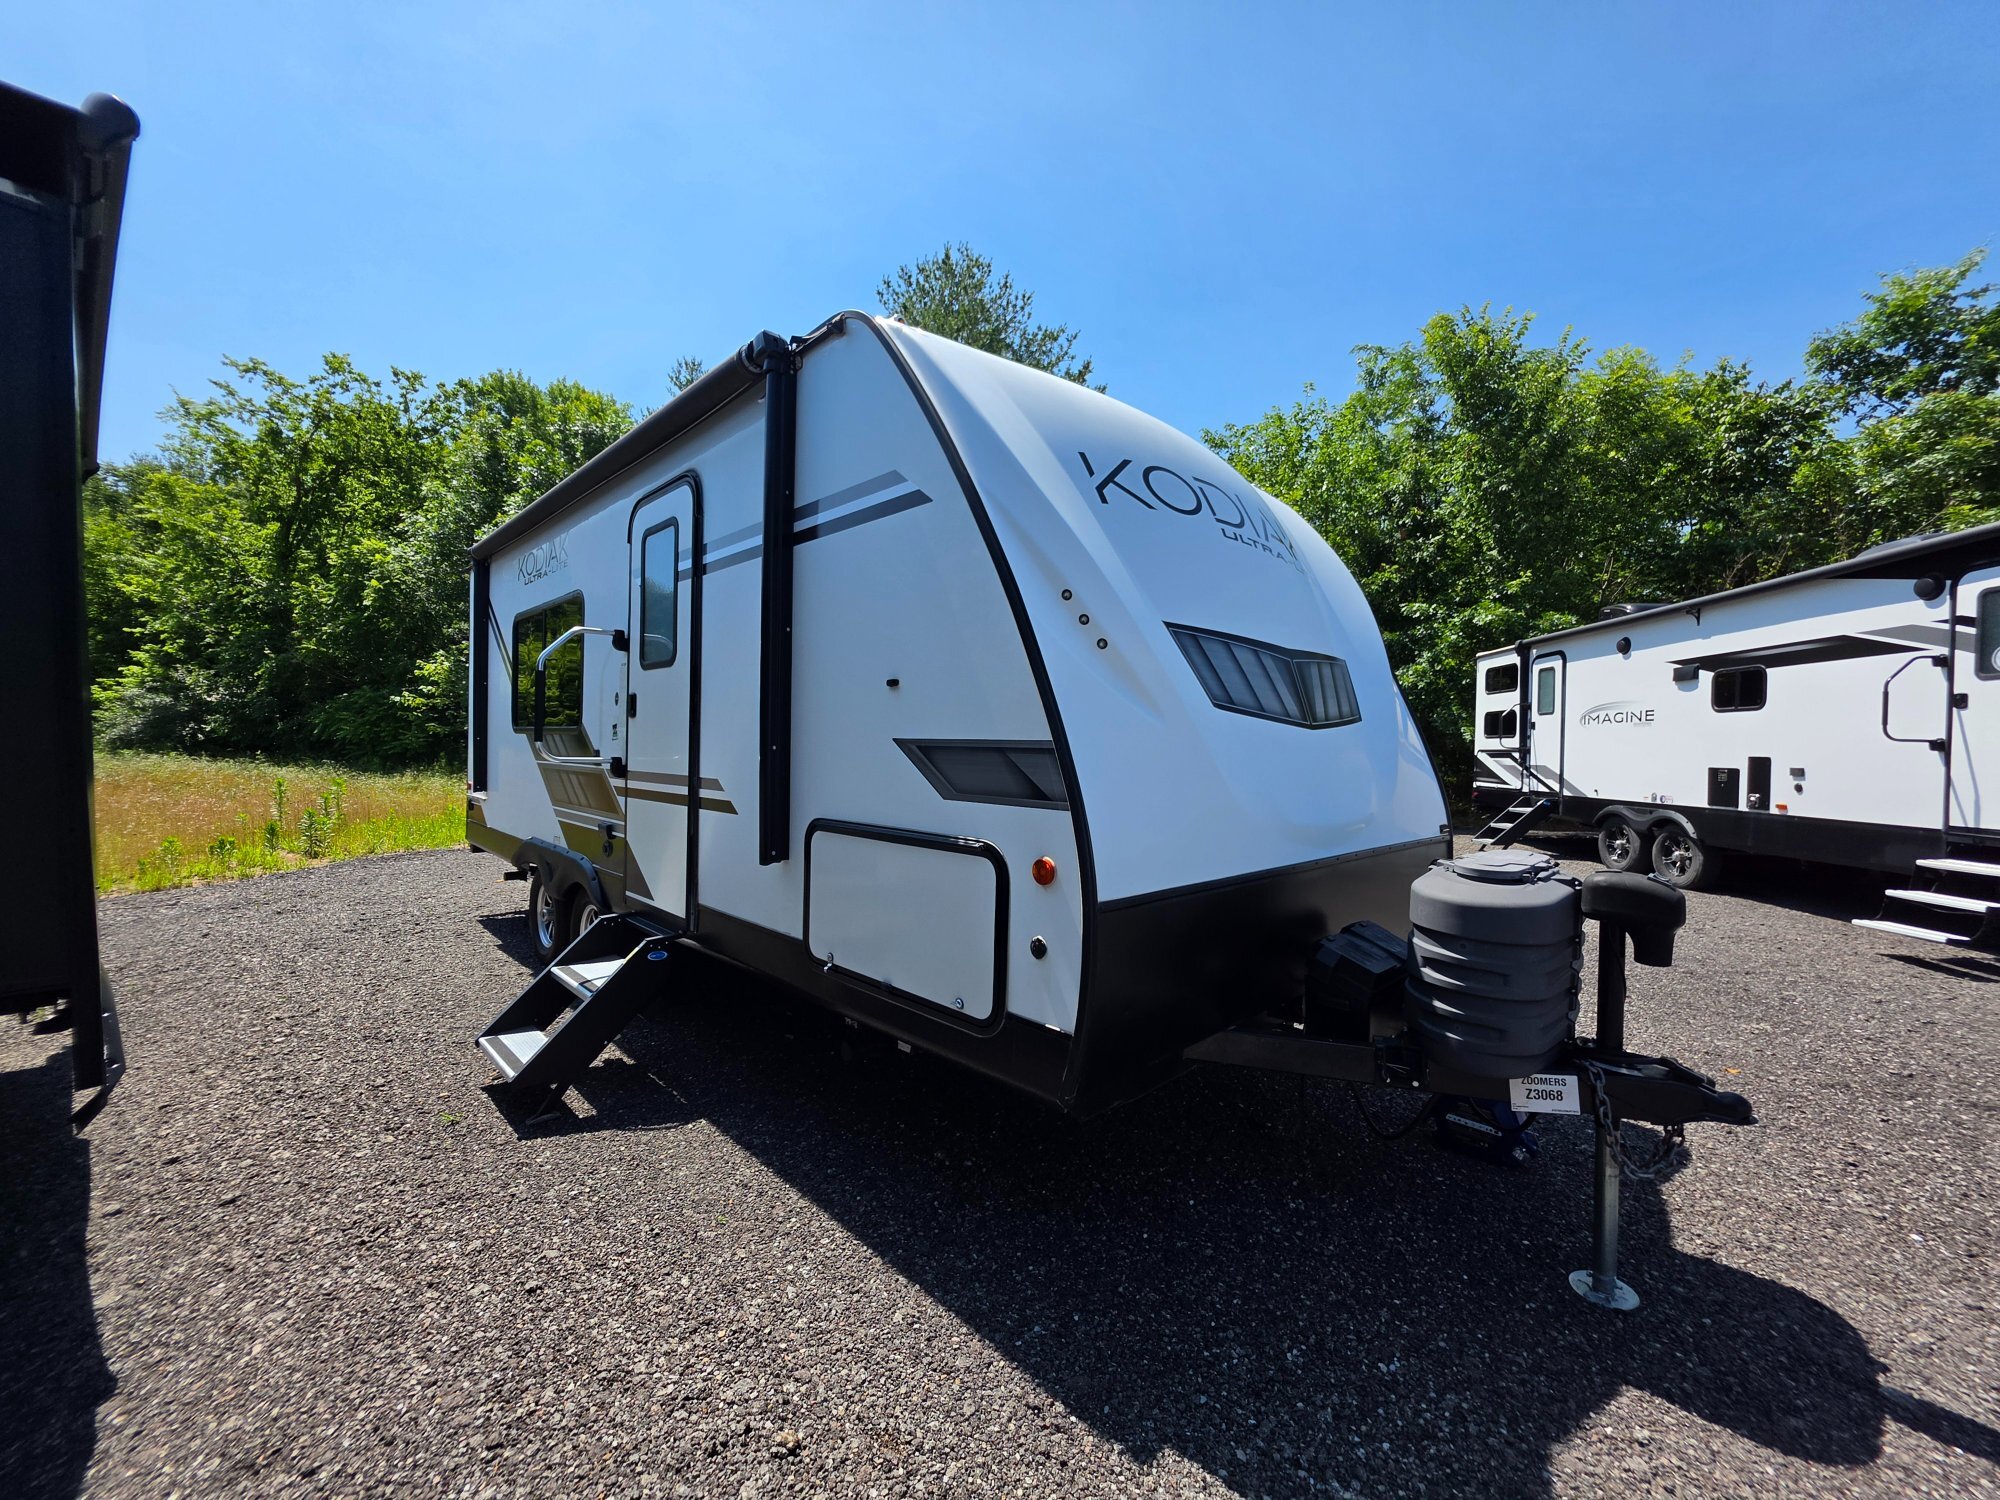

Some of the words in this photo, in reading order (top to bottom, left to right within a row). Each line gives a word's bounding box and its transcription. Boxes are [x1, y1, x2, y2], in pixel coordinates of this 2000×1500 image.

[517, 531, 568, 582] KODIAK
[1582, 709, 1655, 725] IMAGINE
[1521, 1076, 1567, 1087] ZOOMERS
[1525, 1088, 1564, 1102] Z3068
